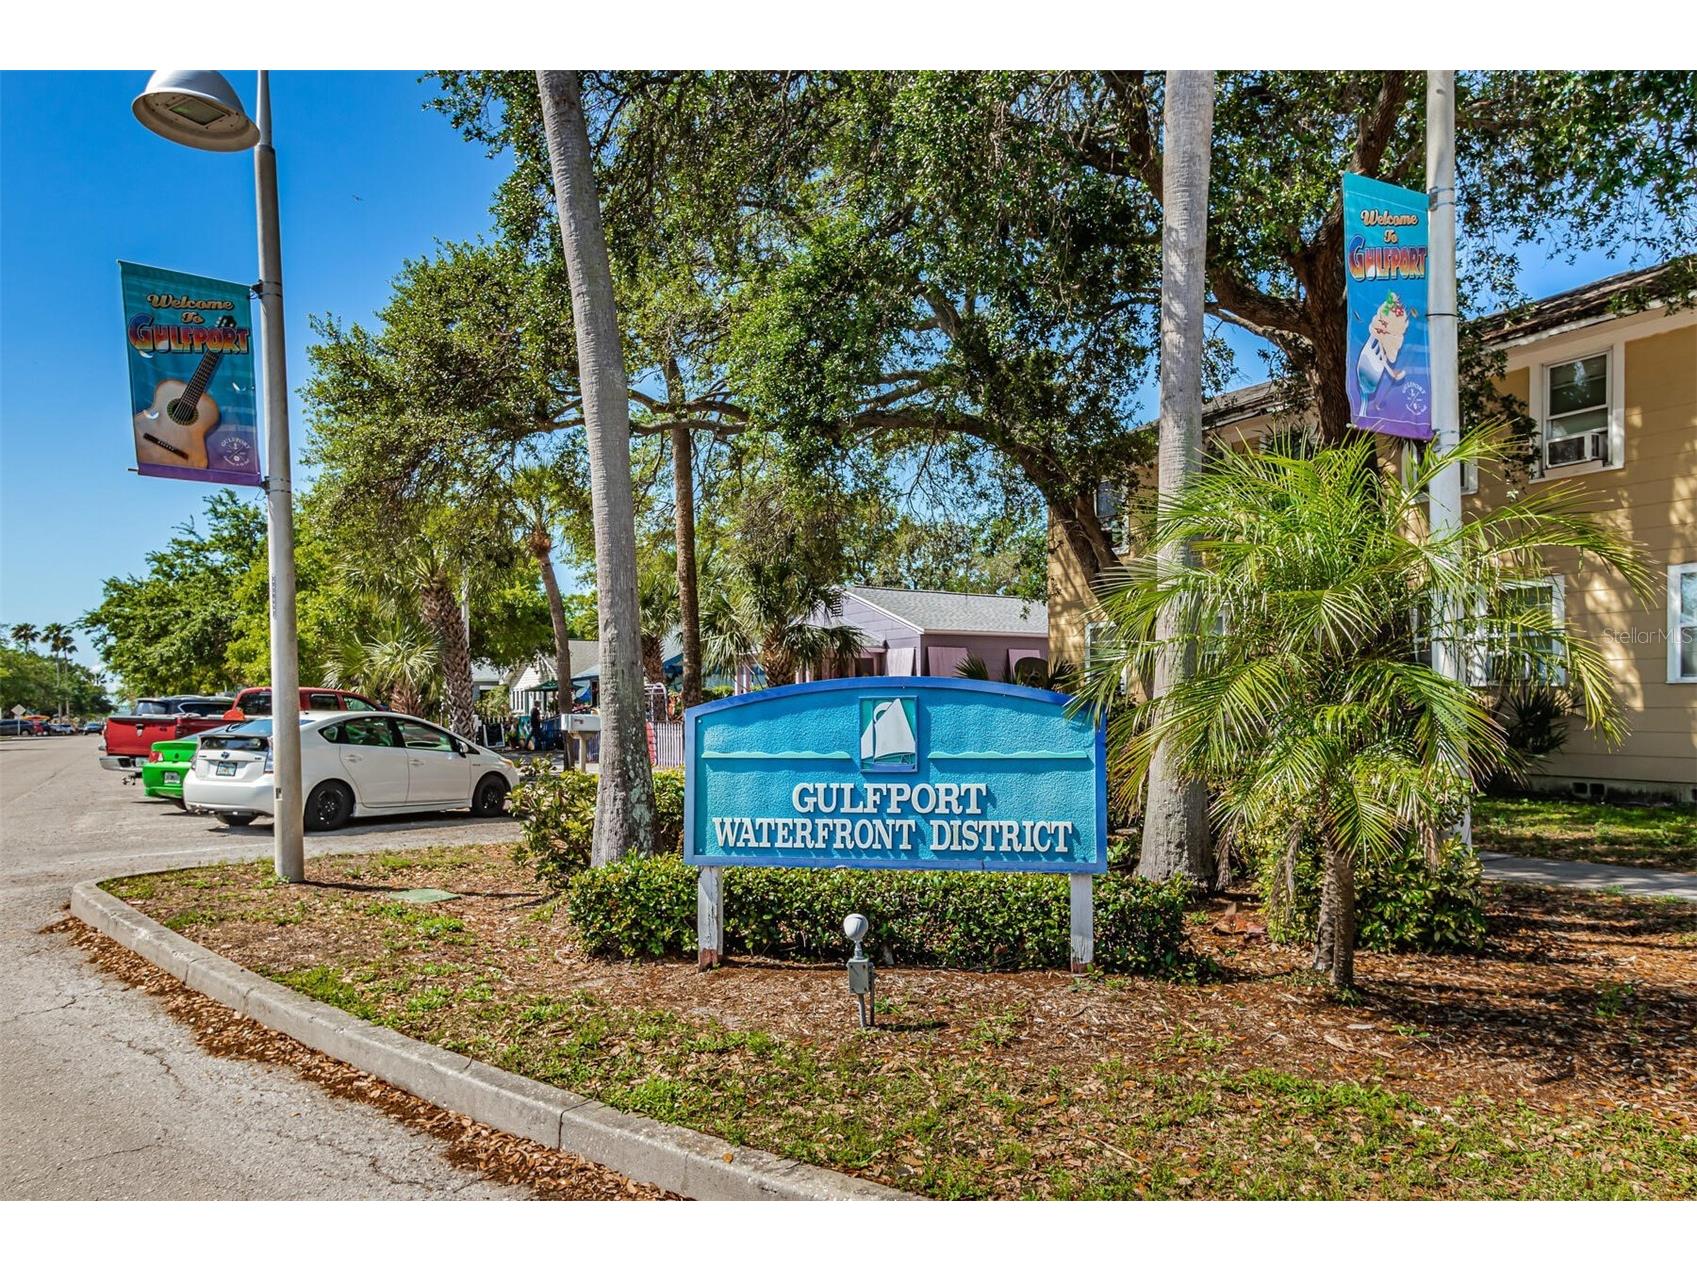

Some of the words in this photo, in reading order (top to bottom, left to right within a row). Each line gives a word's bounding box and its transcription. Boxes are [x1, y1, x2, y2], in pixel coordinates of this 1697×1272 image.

[1360, 208, 1419, 227] Welcome
[1383, 229, 1398, 244] To
[1348, 235, 1427, 282] GULFPORT
[147, 293, 234, 311] Welcome
[181, 311, 204, 324] To
[128, 313, 250, 354] GULFPORT
[792, 782, 987, 815] GULFPORT
[712, 817, 916, 850] WATERFRONT
[930, 820, 1073, 853] DISTRICT
